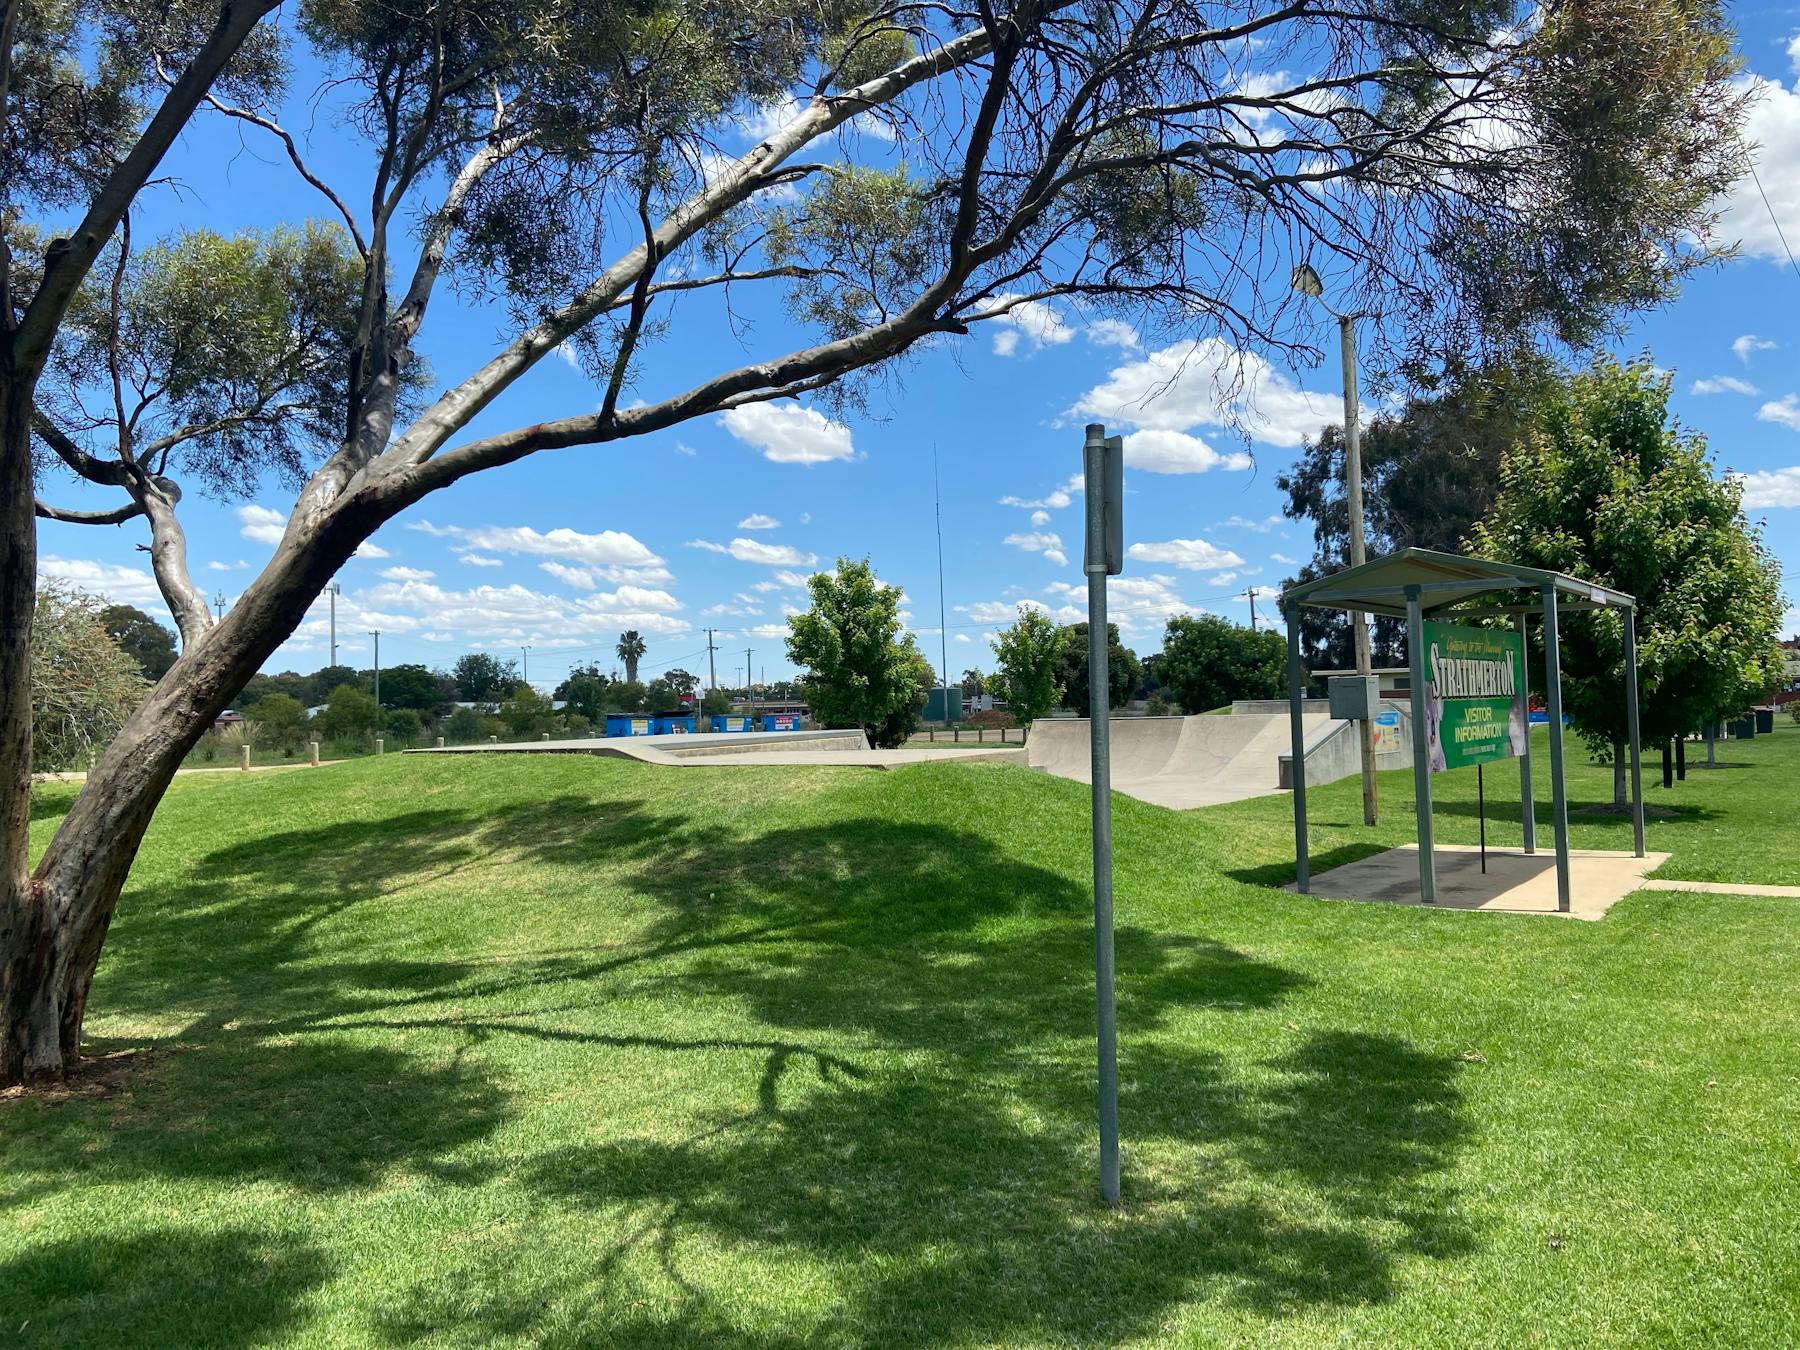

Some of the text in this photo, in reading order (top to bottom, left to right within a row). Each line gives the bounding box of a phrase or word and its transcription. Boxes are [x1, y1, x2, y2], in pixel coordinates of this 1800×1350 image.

[1430, 642, 1515, 698] STRATHMERTON
[1464, 707, 1492, 722] VISITOR
[1455, 722, 1501, 743] INFORMATION
